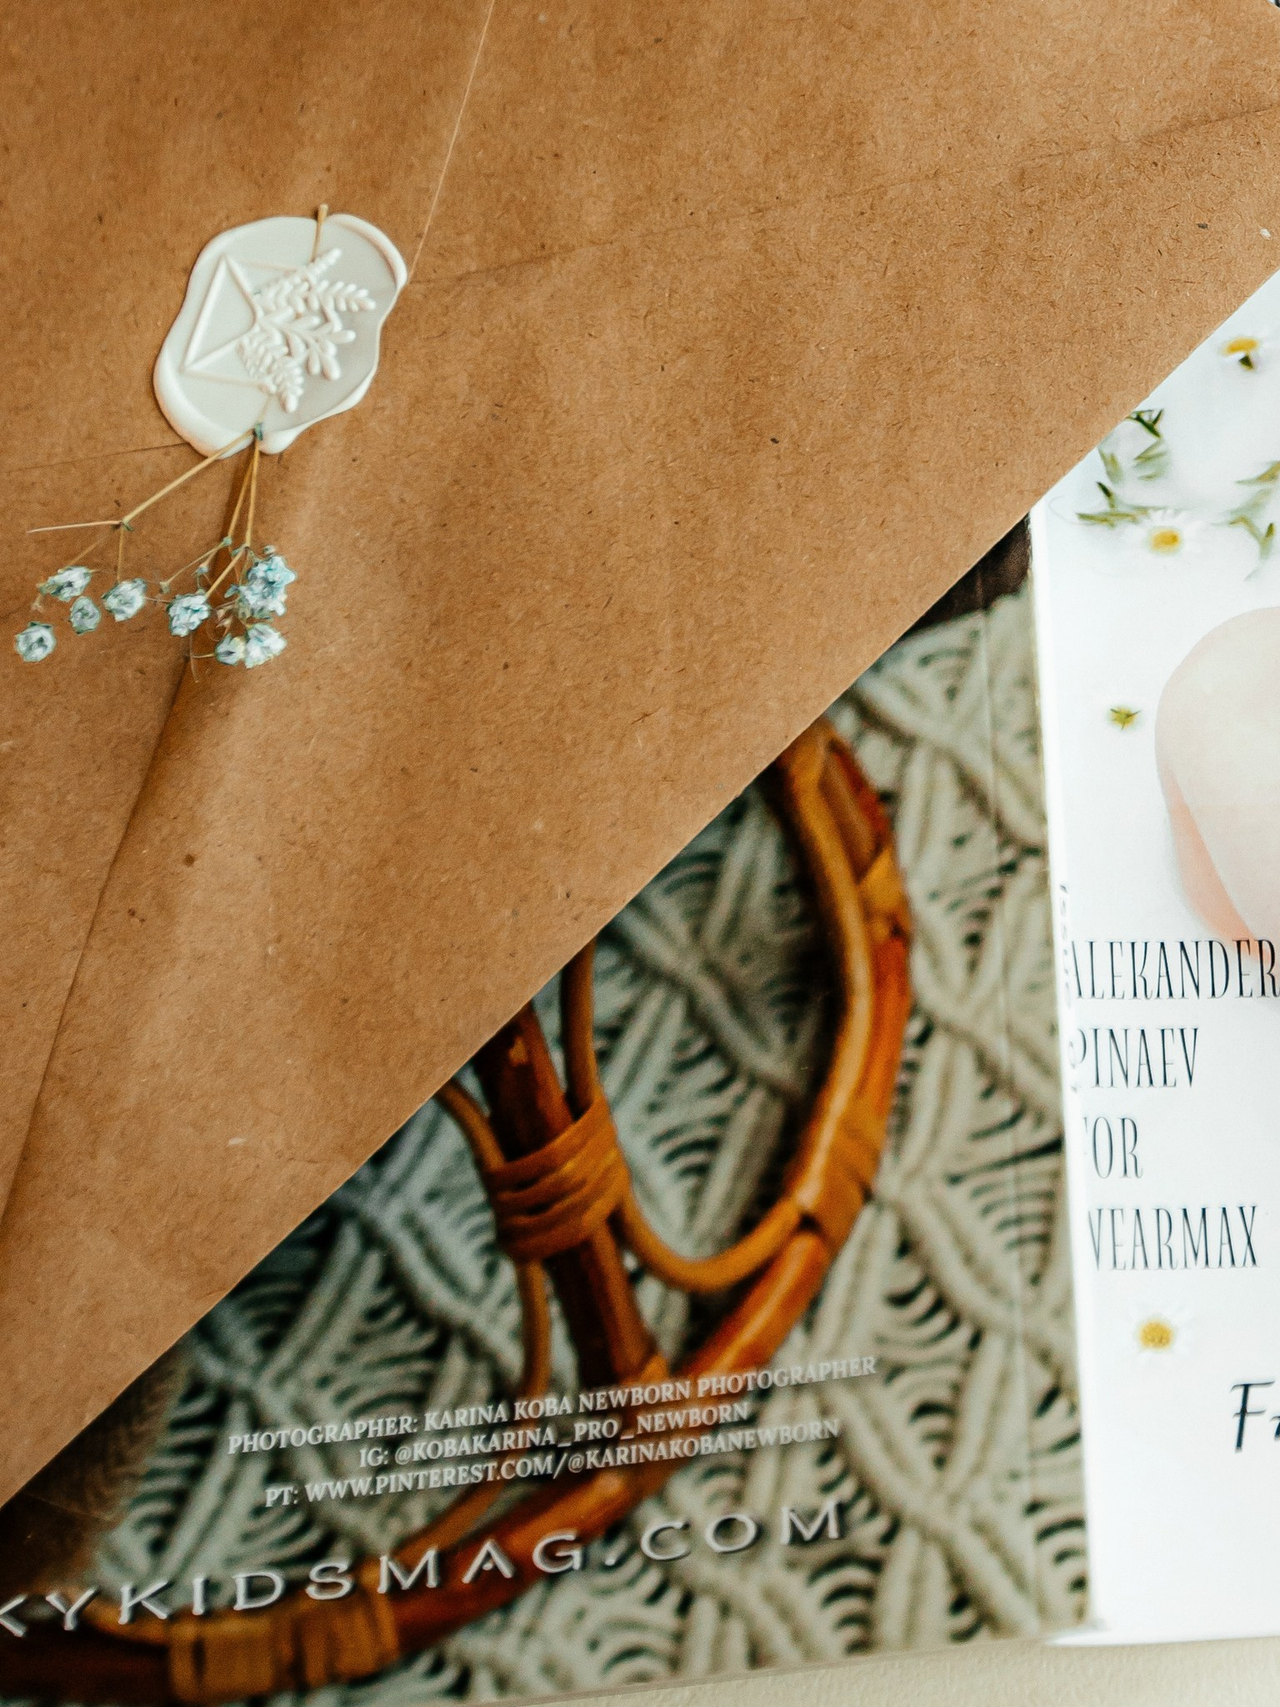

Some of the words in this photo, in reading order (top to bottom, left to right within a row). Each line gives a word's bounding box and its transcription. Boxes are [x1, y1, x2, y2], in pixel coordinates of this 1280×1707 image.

[1083, 1116, 1143, 1179] OR
[227, 1416, 418, 1455] PHOTOGRAPHER:
[424, 1402, 508, 1432] KARINA
[514, 1391, 573, 1421] KOBA
[579, 1381, 692, 1413] NEWBORN
[697, 1355, 878, 1397] PHOTOGRAPHER
[358, 1446, 389, 1468] IG:
[265, 1485, 299, 1508] PT:
